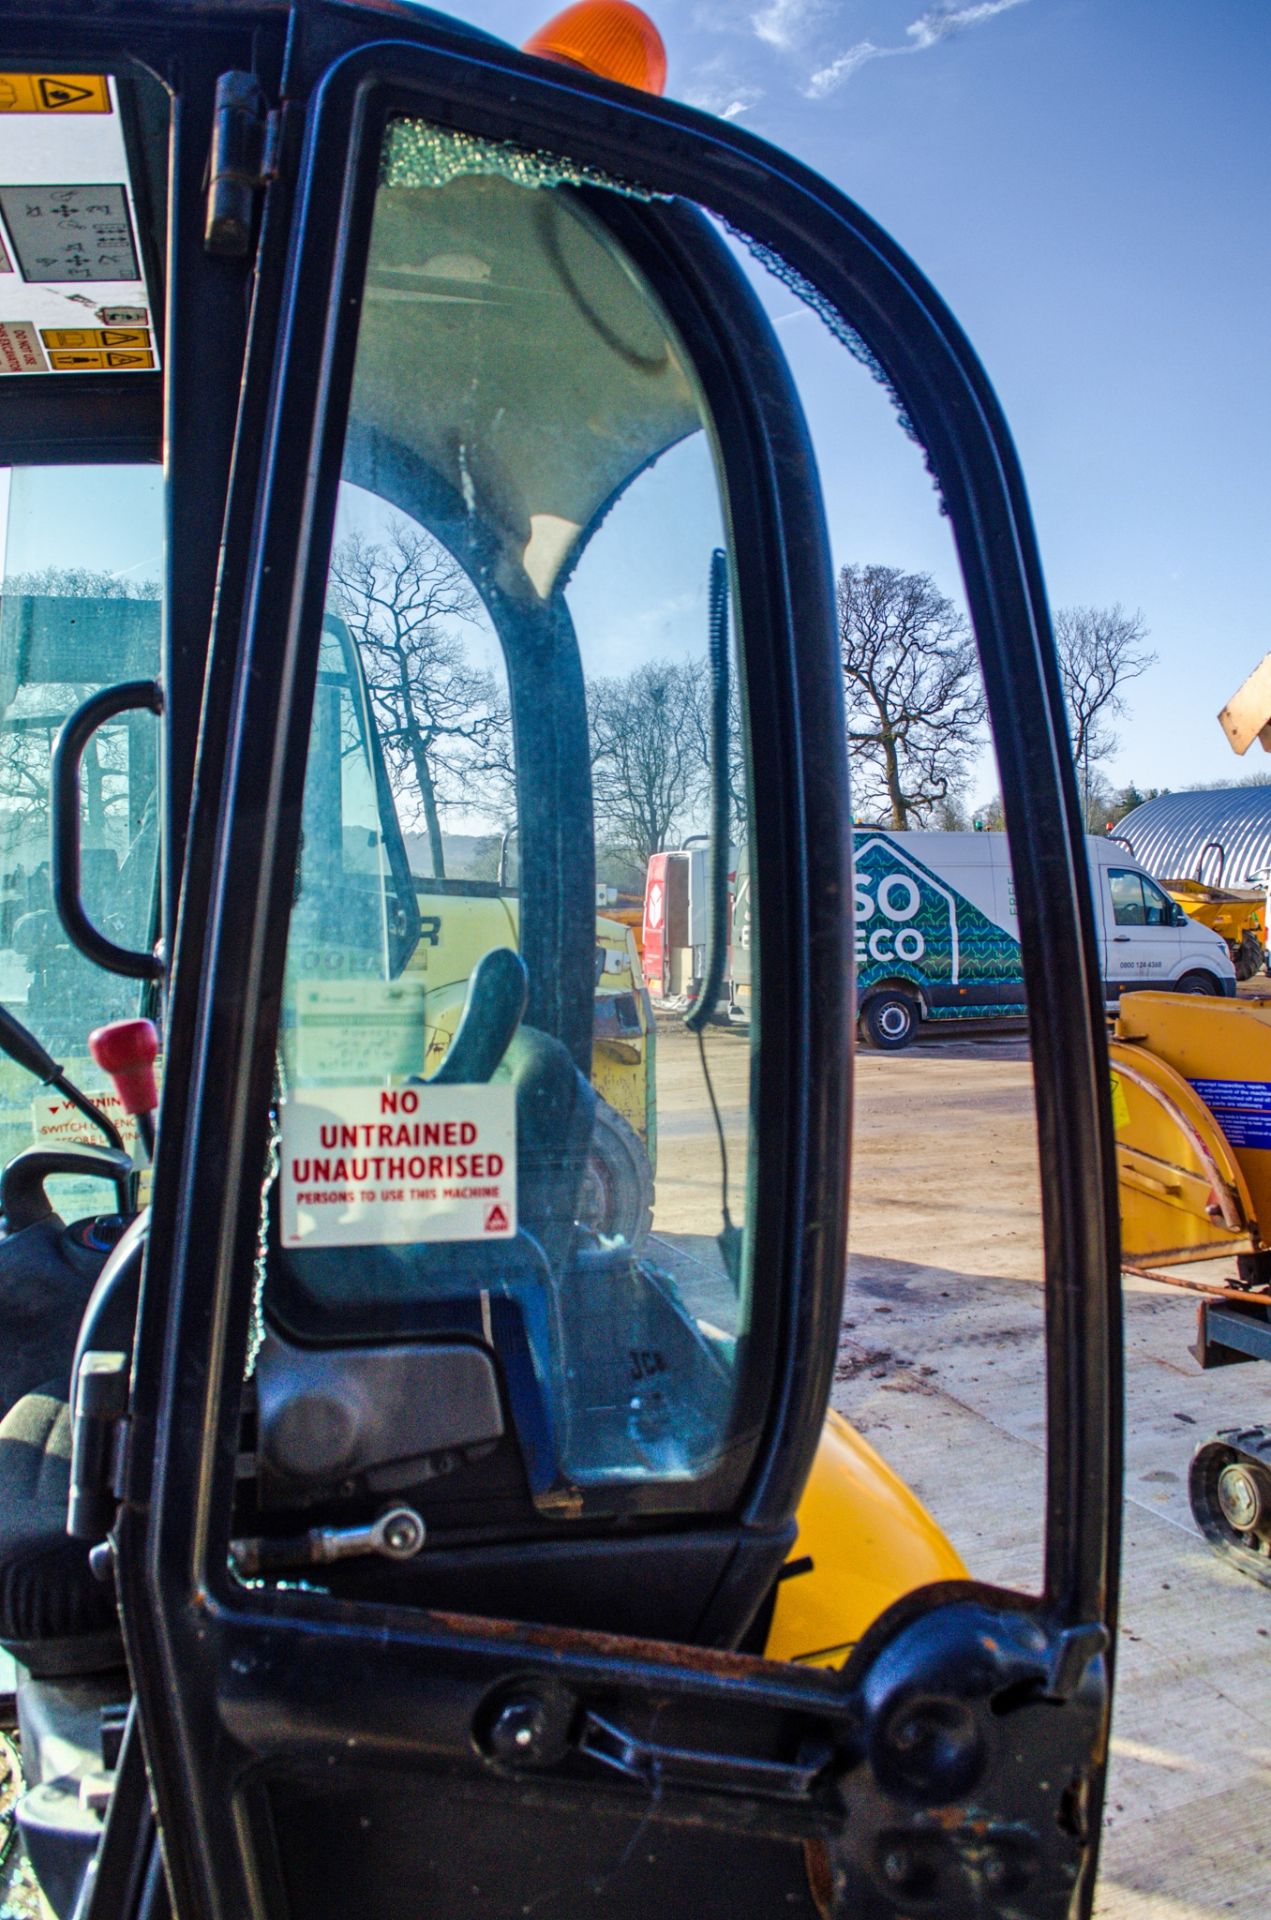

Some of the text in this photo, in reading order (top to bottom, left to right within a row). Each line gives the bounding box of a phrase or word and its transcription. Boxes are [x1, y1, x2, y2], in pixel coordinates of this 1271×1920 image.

[381, 1090, 418, 1114] NO
[320, 1121, 478, 1149] UNTRAINED
[292, 1154, 504, 1183] UNAUTHORISED
[296, 1185, 499, 1205] PERSONS TO USE THIS MACHINE
